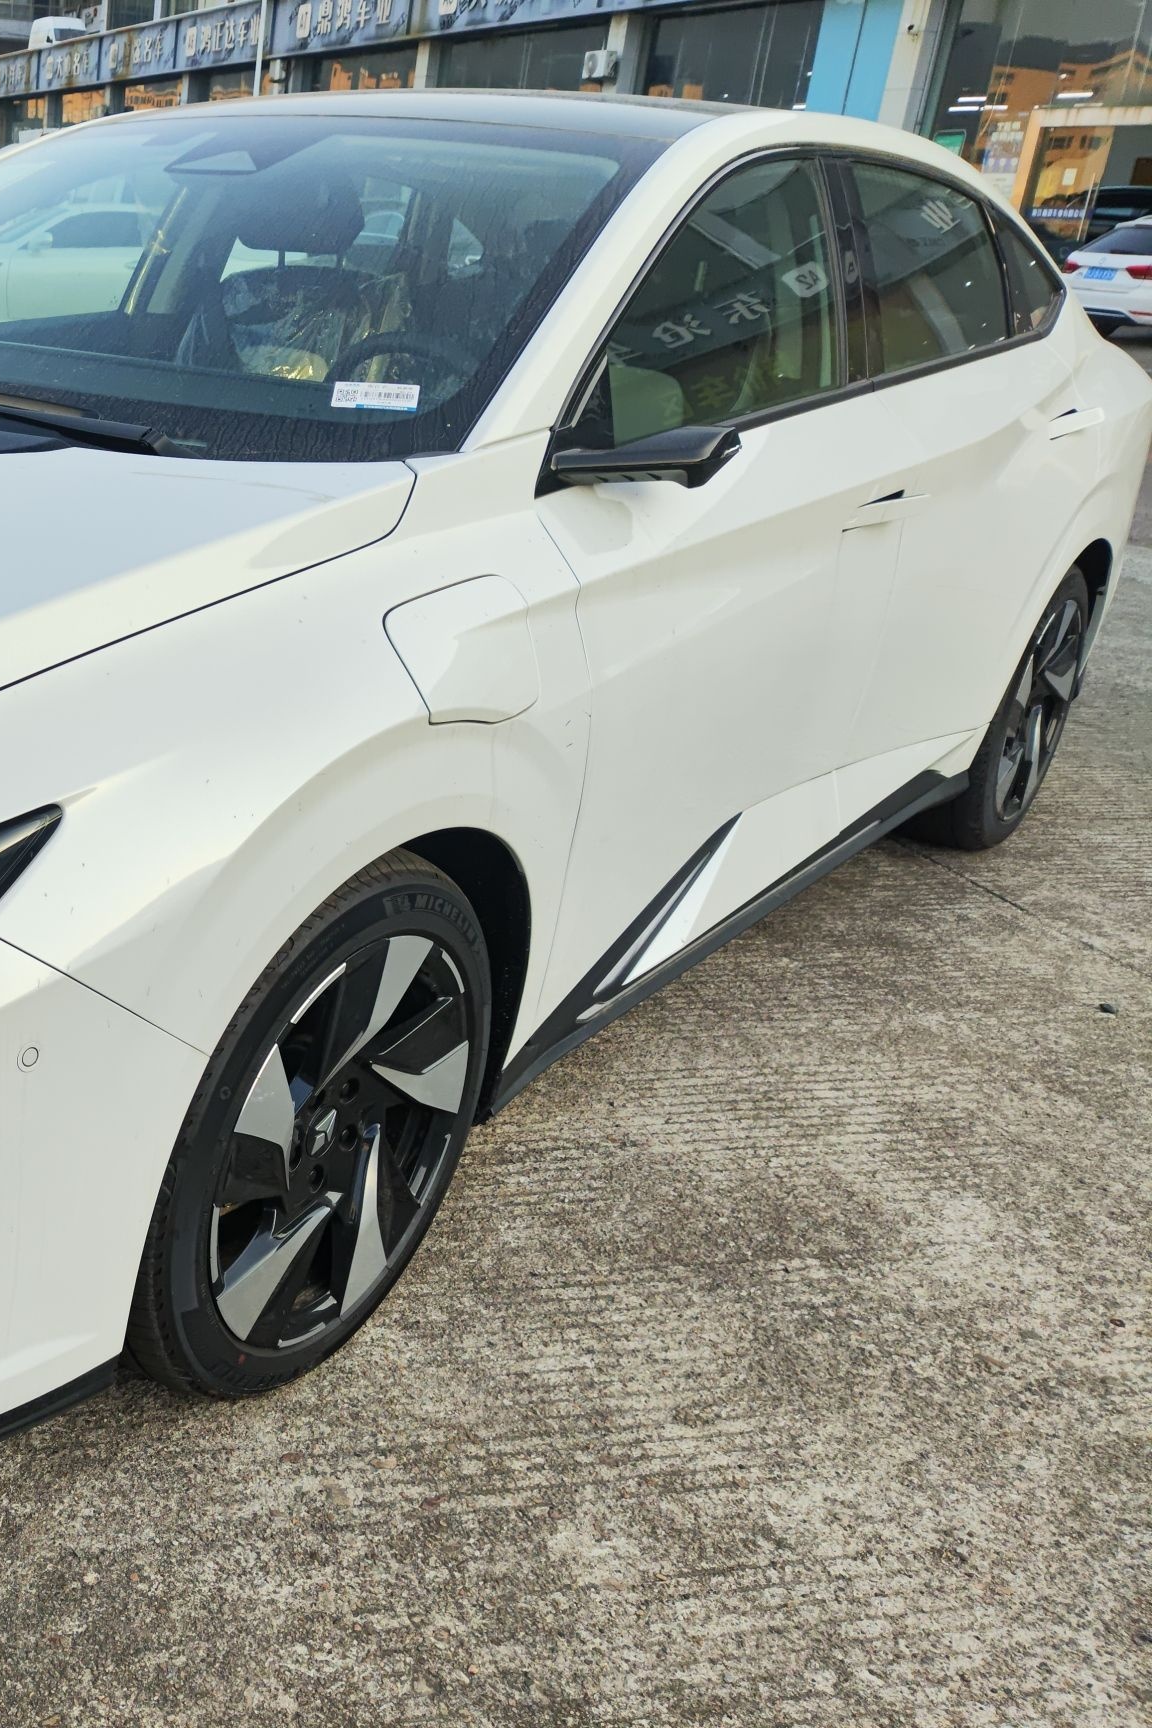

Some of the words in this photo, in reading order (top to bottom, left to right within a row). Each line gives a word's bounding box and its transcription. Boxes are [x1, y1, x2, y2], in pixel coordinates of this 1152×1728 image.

[200, 15, 260, 54] 鸿正达车业
[414, 894, 479, 944] MICHELIN
